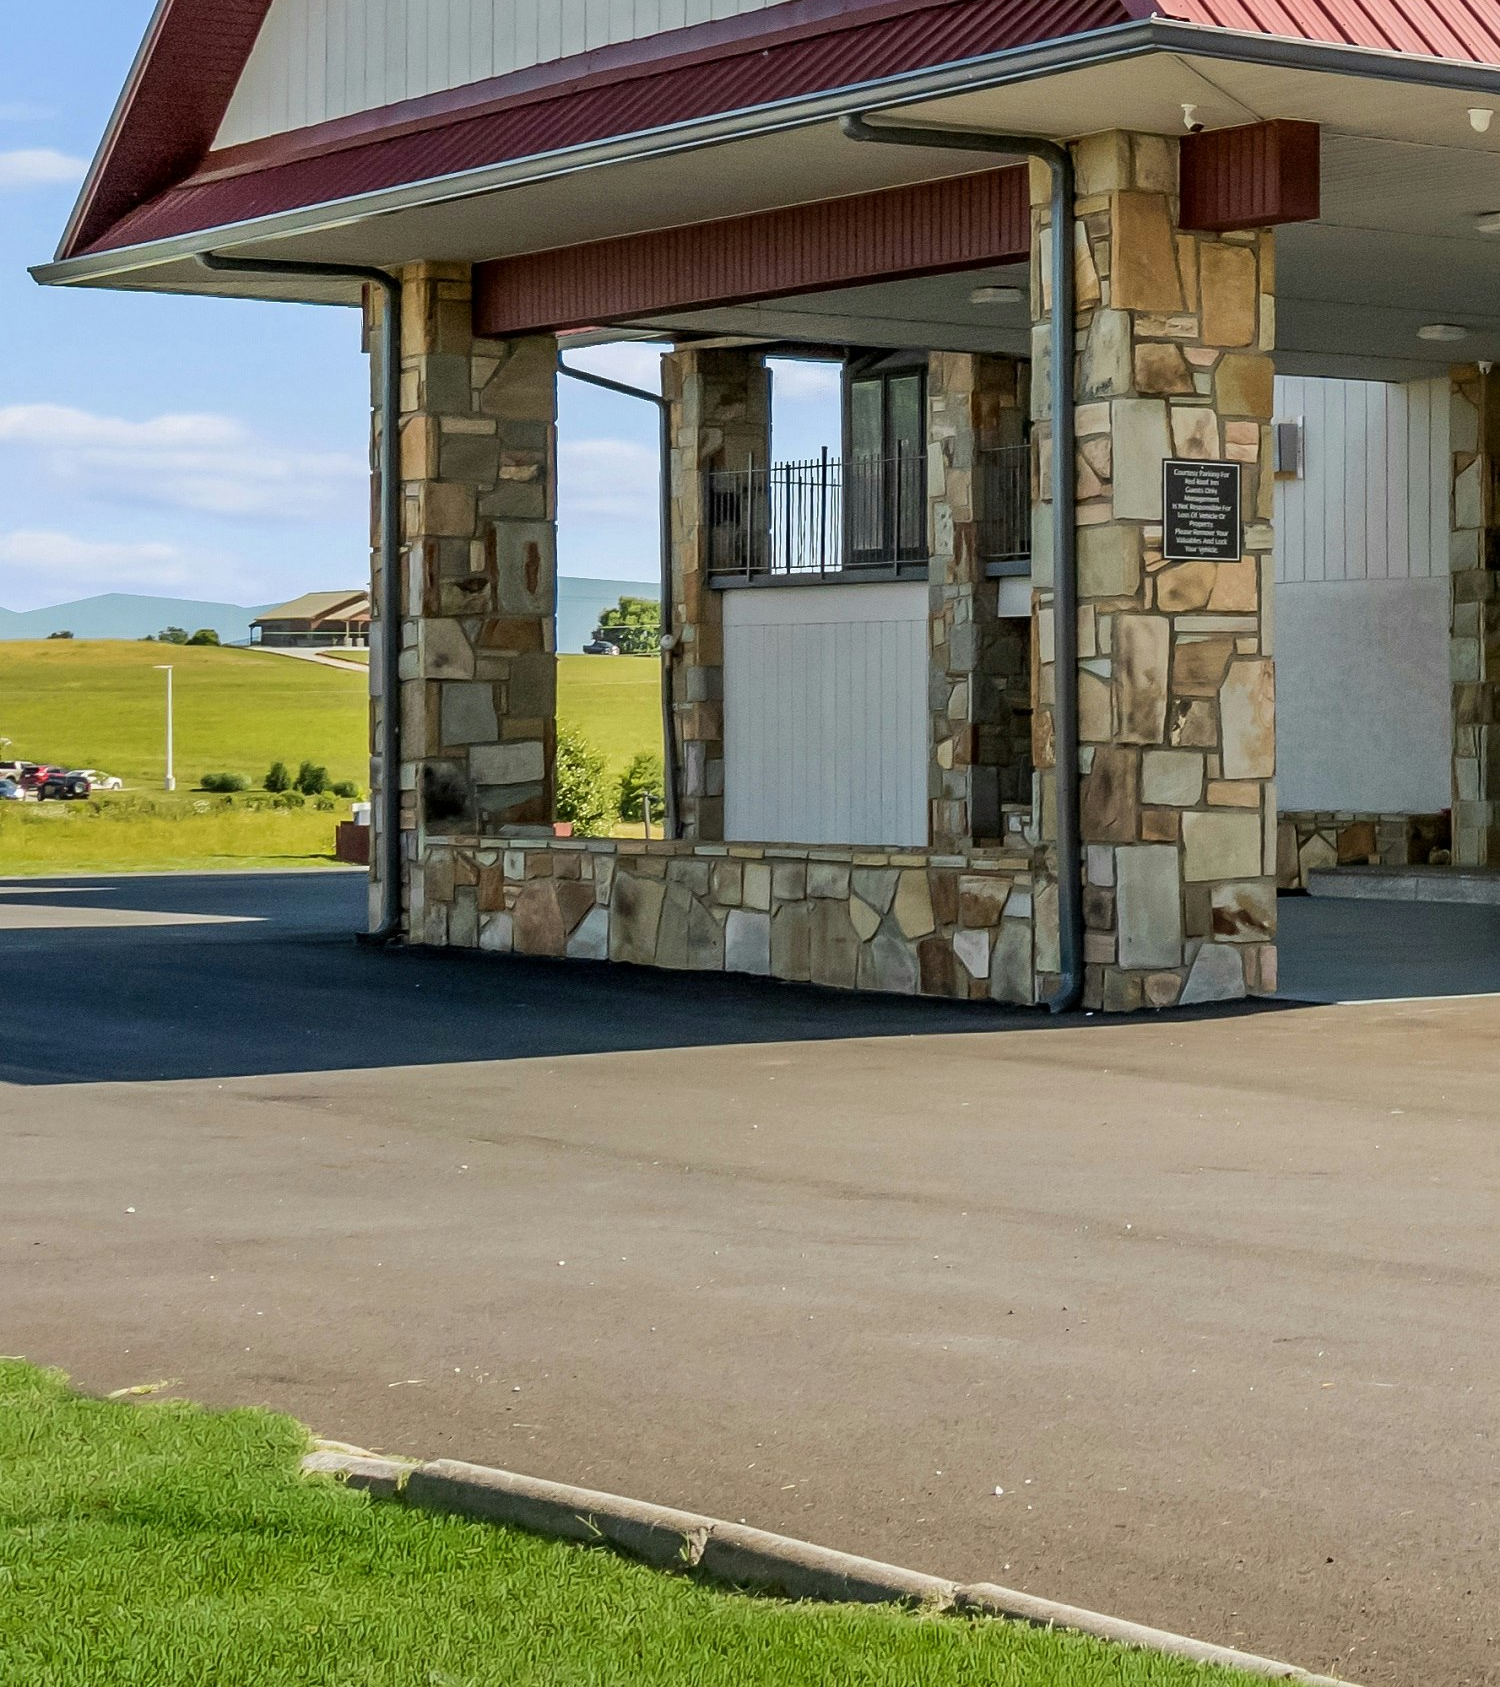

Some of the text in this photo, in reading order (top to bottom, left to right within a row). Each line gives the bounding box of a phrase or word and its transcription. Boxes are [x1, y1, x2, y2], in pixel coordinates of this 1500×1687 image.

[1199, 470, 1220, 479] Parking
[1185, 486, 1217, 495] Guests Only
[1184, 495, 1220, 503] Management
[1190, 503, 1222, 512] Responsible
[1215, 537, 1228, 545] Lock
